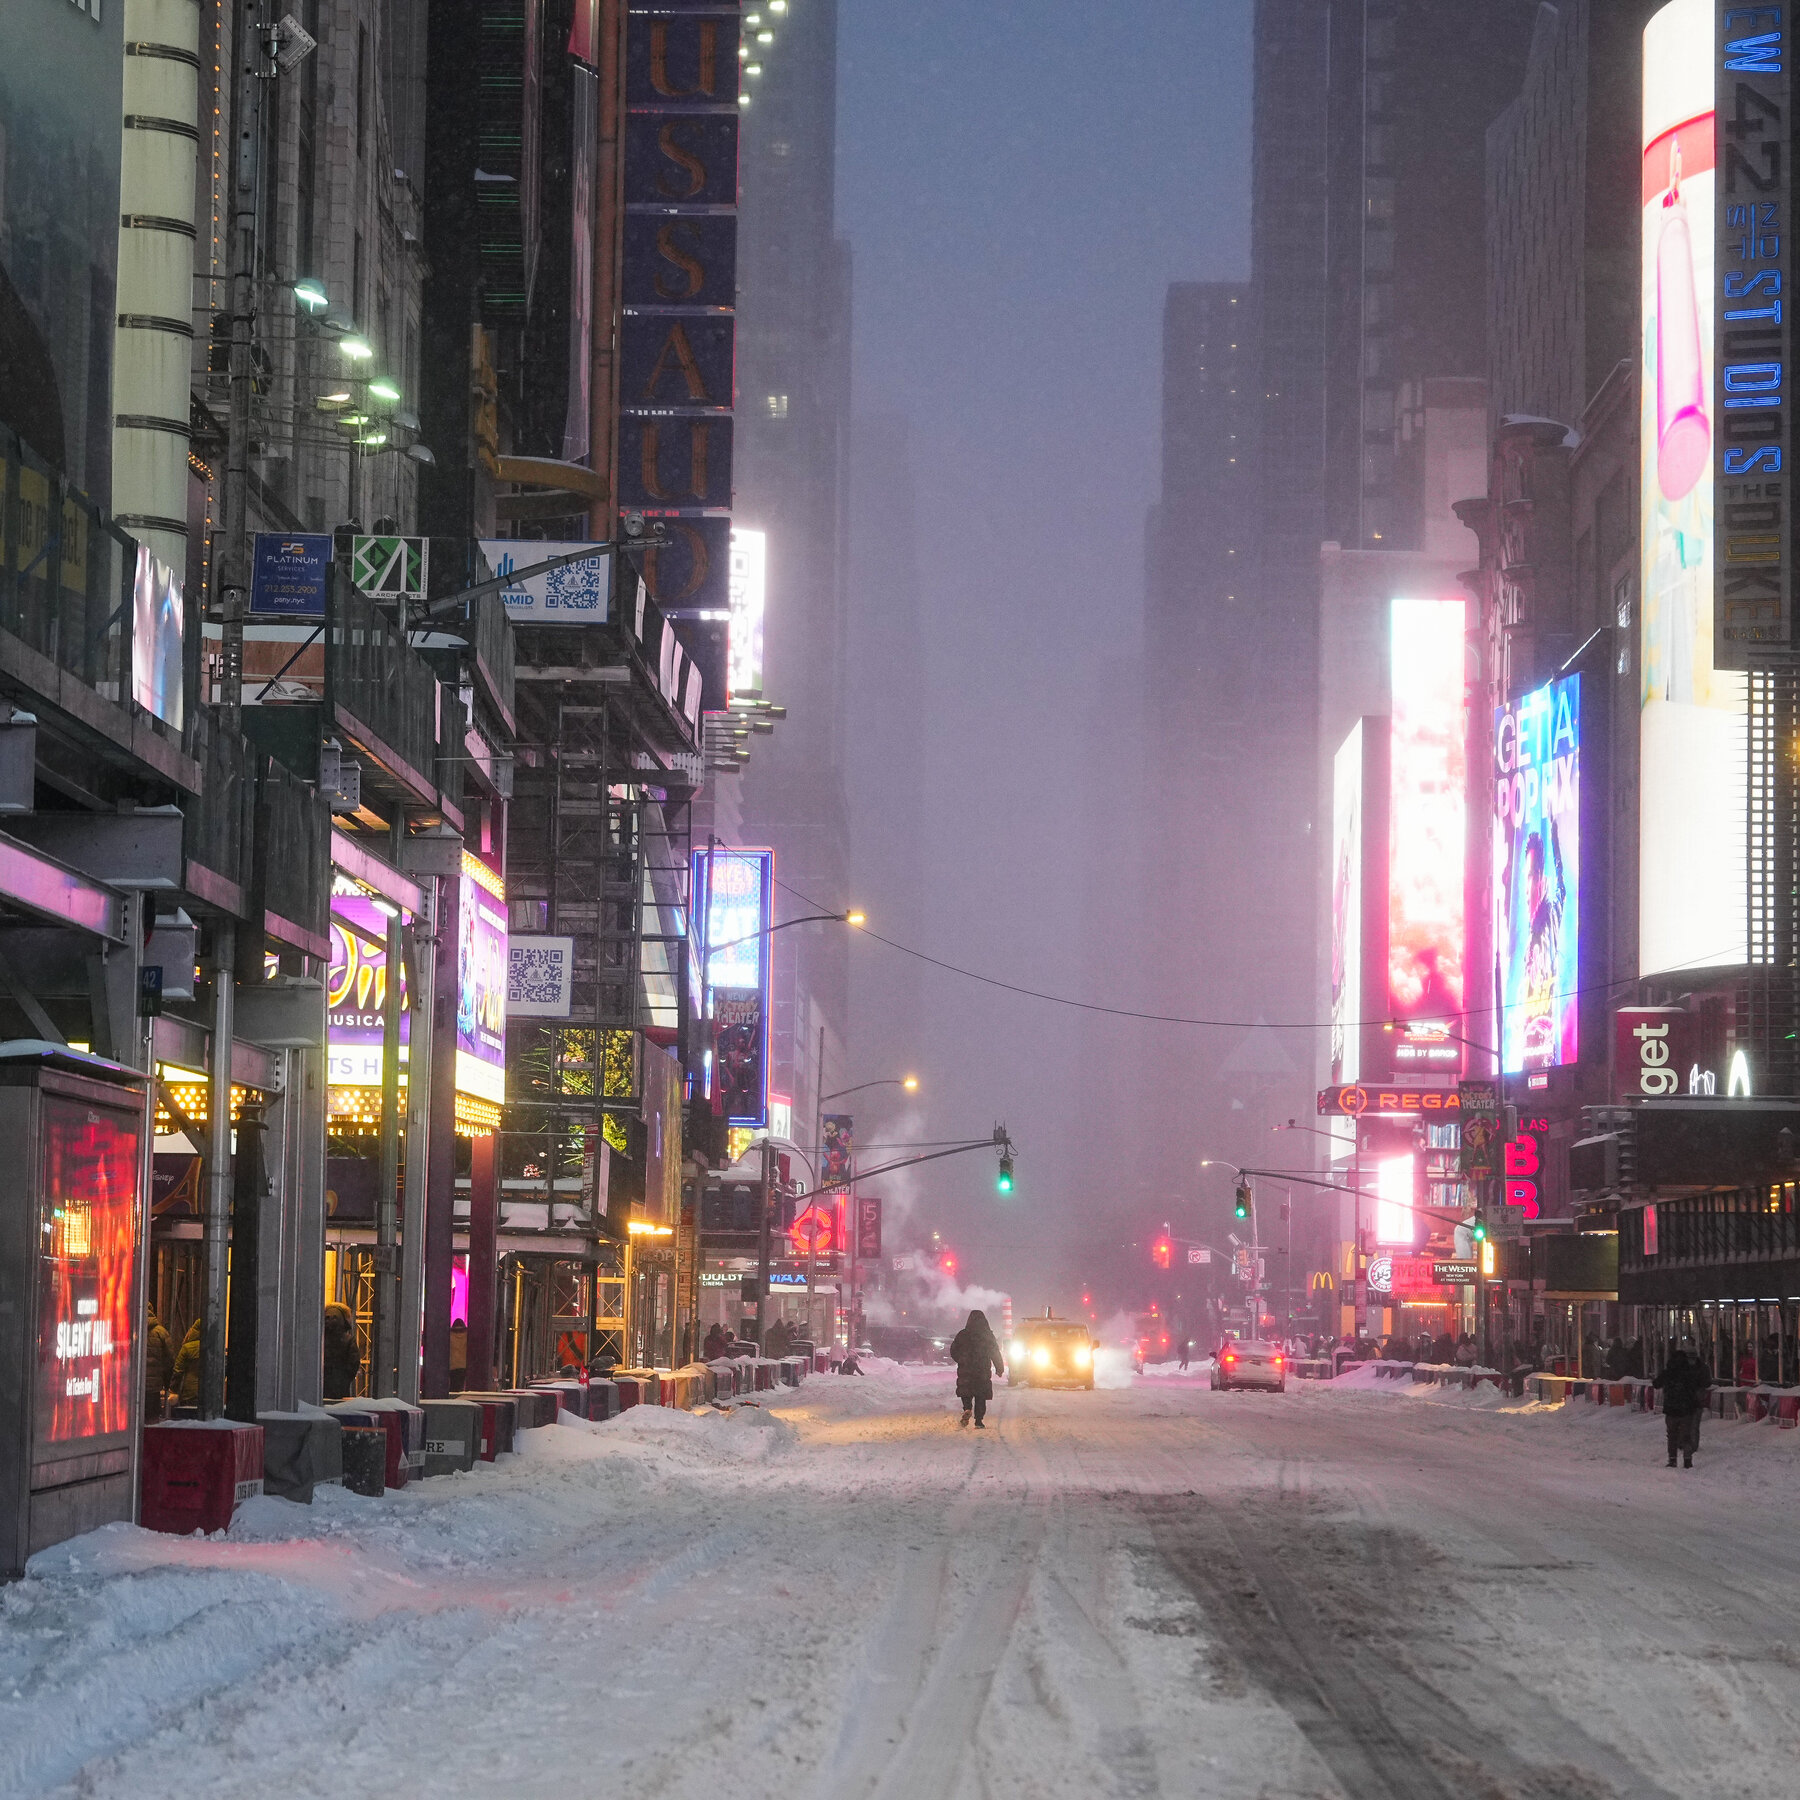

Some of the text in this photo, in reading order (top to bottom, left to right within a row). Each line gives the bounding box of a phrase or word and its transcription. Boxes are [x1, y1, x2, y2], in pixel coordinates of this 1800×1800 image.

[1724, 82, 1782, 194] 42
[1726, 204, 1747, 260] ST
[1760, 203, 1780, 259] ND
[1723, 269, 1782, 475] STUDIOS
[1723, 482, 1783, 498] THE
[266, 555, 319, 565] PLATINUM
[1723, 502, 1782, 621] DUKE
[1497, 690, 1576, 774] GET A
[1497, 767, 1539, 829] POP
[715, 1010, 760, 1025] THEATER
[1417, 1049, 1428, 1057] BY
[1460, 1099, 1495, 1110] THEATER
[1493, 1207, 1517, 1215] NYPD
[1433, 1264, 1478, 1273] THE WESTIN
